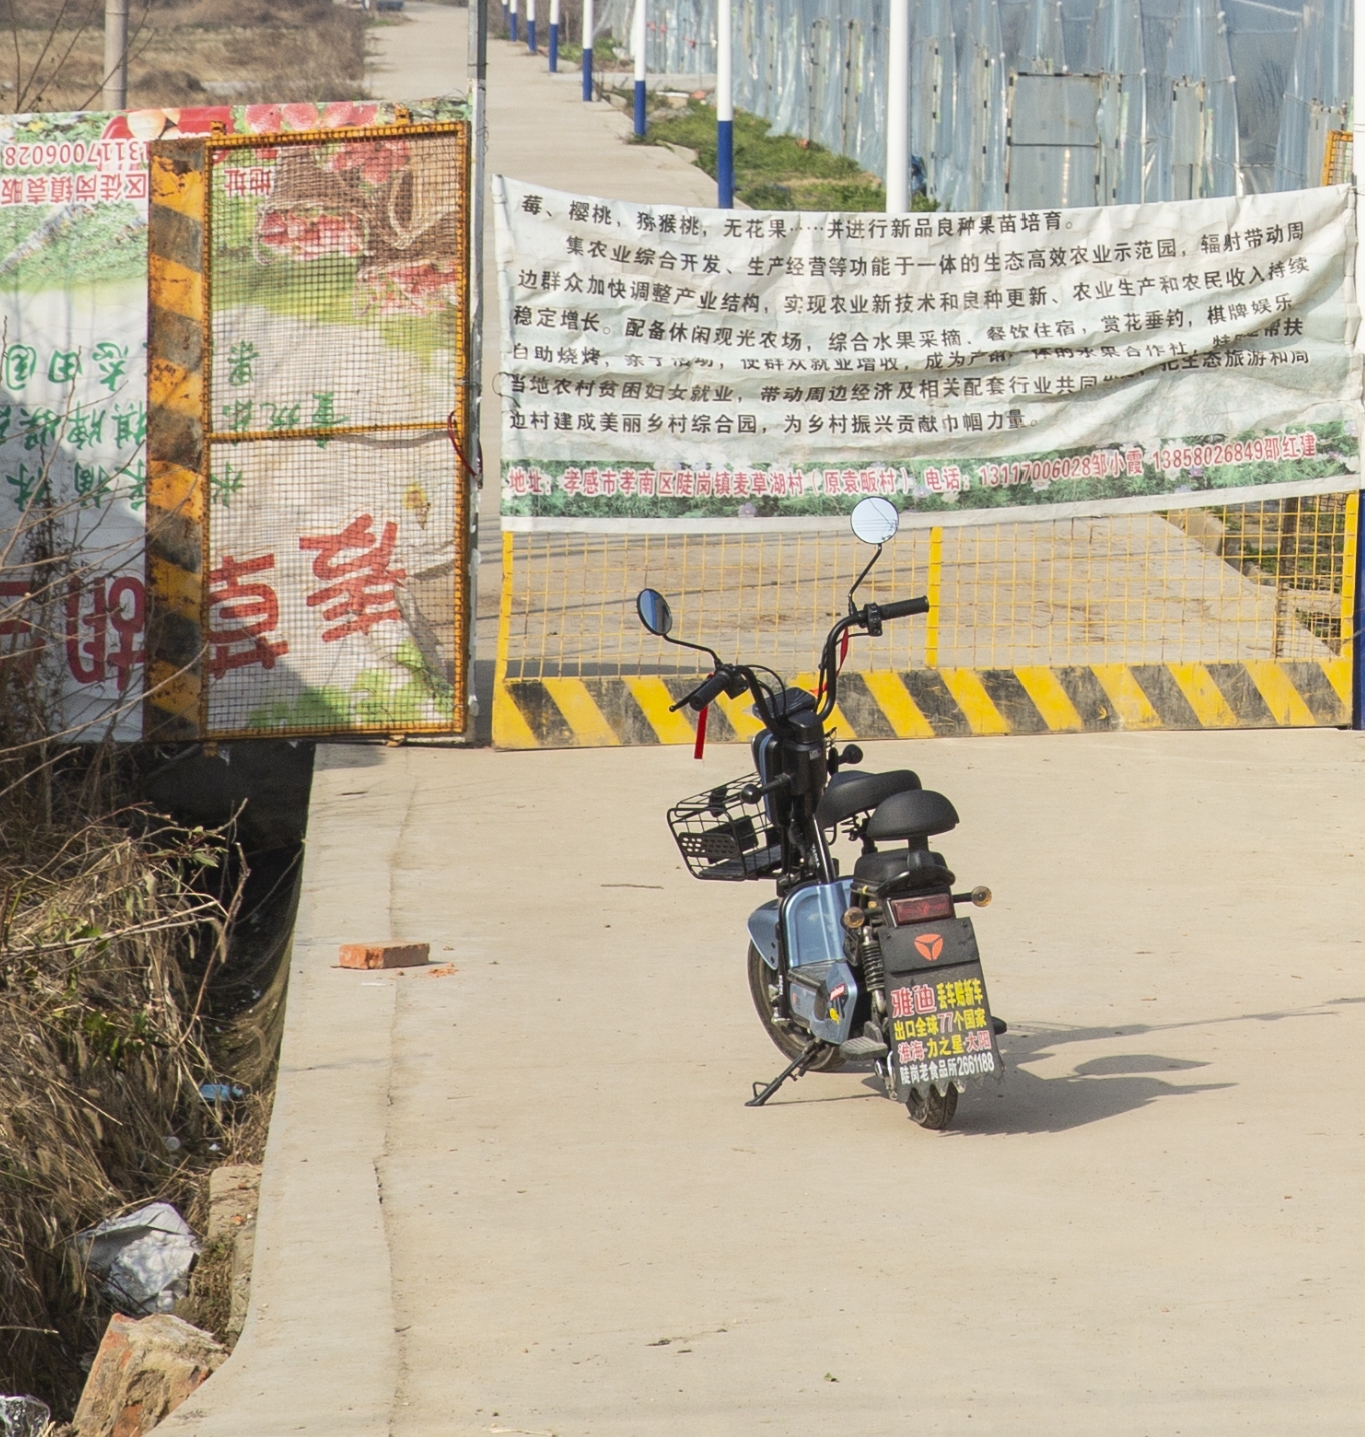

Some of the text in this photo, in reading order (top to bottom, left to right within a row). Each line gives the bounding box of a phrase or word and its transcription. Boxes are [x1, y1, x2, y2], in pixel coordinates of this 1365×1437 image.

[6, 342, 148, 391] 态田园
[891, 983, 937, 1018] 雅迪
